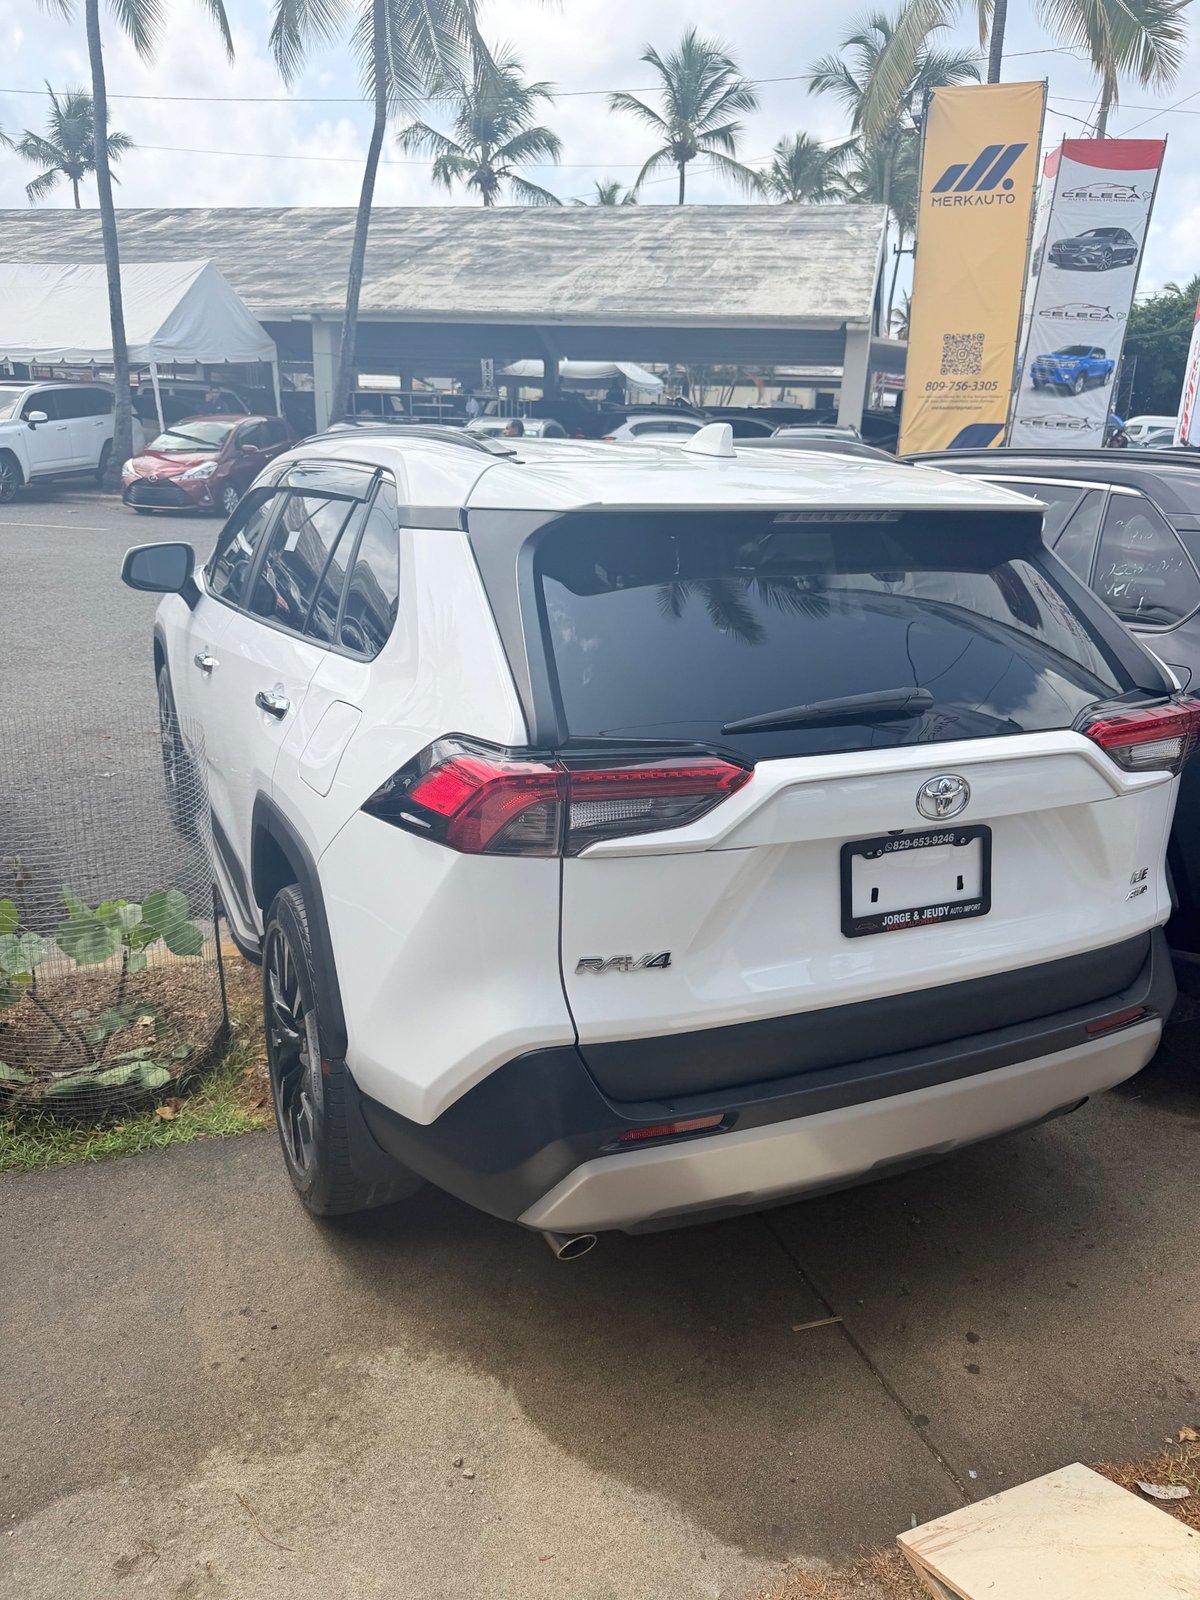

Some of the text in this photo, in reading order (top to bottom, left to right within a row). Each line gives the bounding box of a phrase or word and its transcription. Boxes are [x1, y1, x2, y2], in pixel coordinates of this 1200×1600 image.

[931, 193, 1016, 207] MERKAUTO
[1061, 192, 1141, 200] CELECA
[1039, 310, 1115, 320] CELECA
[925, 381, 999, 391] 809-756-3305
[1019, 419, 1093, 430] CELECA
[893, 833, 955, 850] 829-653-9246
[882, 903, 982, 926] JORGE & JEUDY AUTO IMPORT
[575, 949, 672, 975] RAV4
